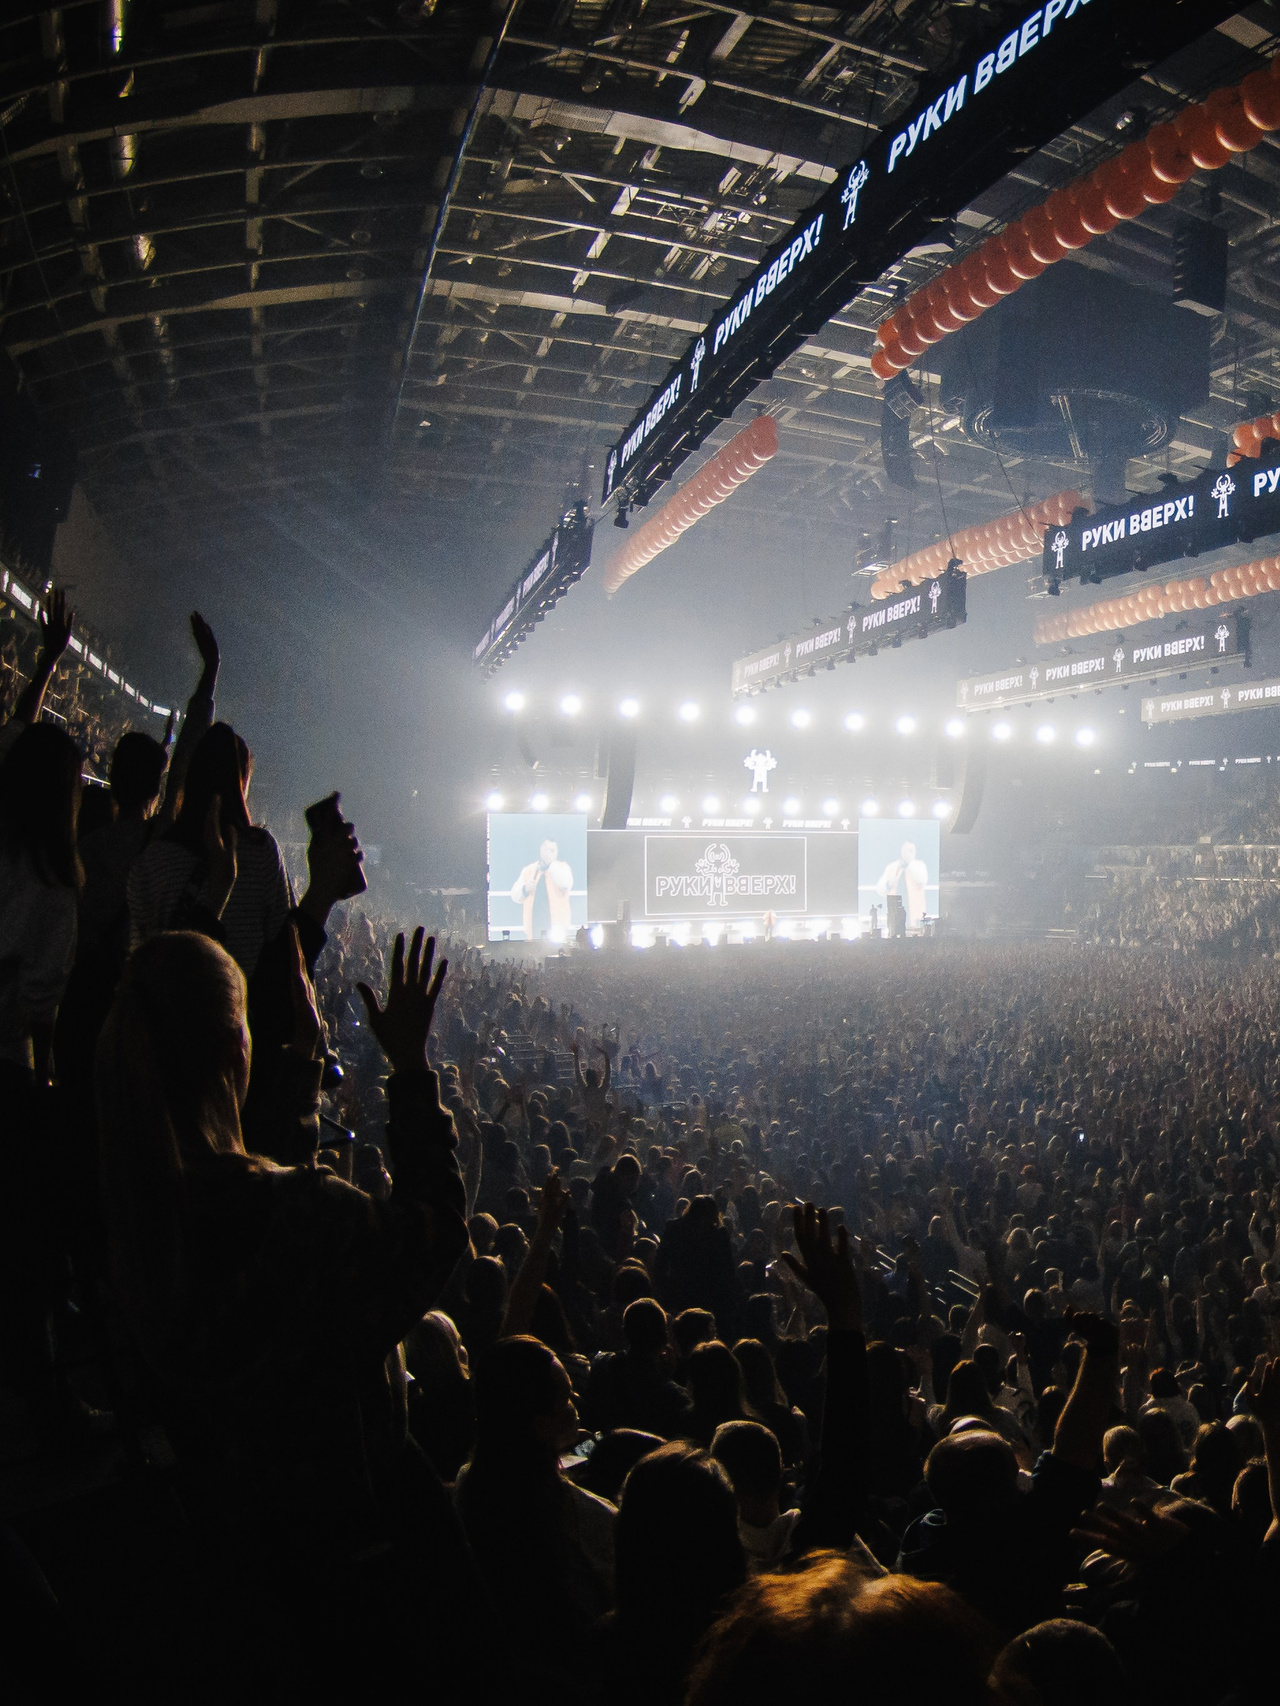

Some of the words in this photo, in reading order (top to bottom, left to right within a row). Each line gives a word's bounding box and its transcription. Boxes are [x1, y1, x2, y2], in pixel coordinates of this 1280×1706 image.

[888, 75, 967, 173] РУКИ
[713, 288, 754, 355] РУКИ
[621, 419, 645, 468] РУКИ
[1081, 519, 1125, 552] РУКИ
[1129, 496, 1195, 537] ВВЕРХ!
[862, 610, 886, 632] РУКИ
[796, 643, 814, 658] РУКИ
[1133, 646, 1162, 664] РУКИ
[1045, 666, 1070, 681] РУКИ
[974, 682, 994, 696] РУКИ
[1238, 688, 1263, 702] РУКИ
[1161, 700, 1183, 713] РУКИ
[656, 875, 712, 896] РУКИ
